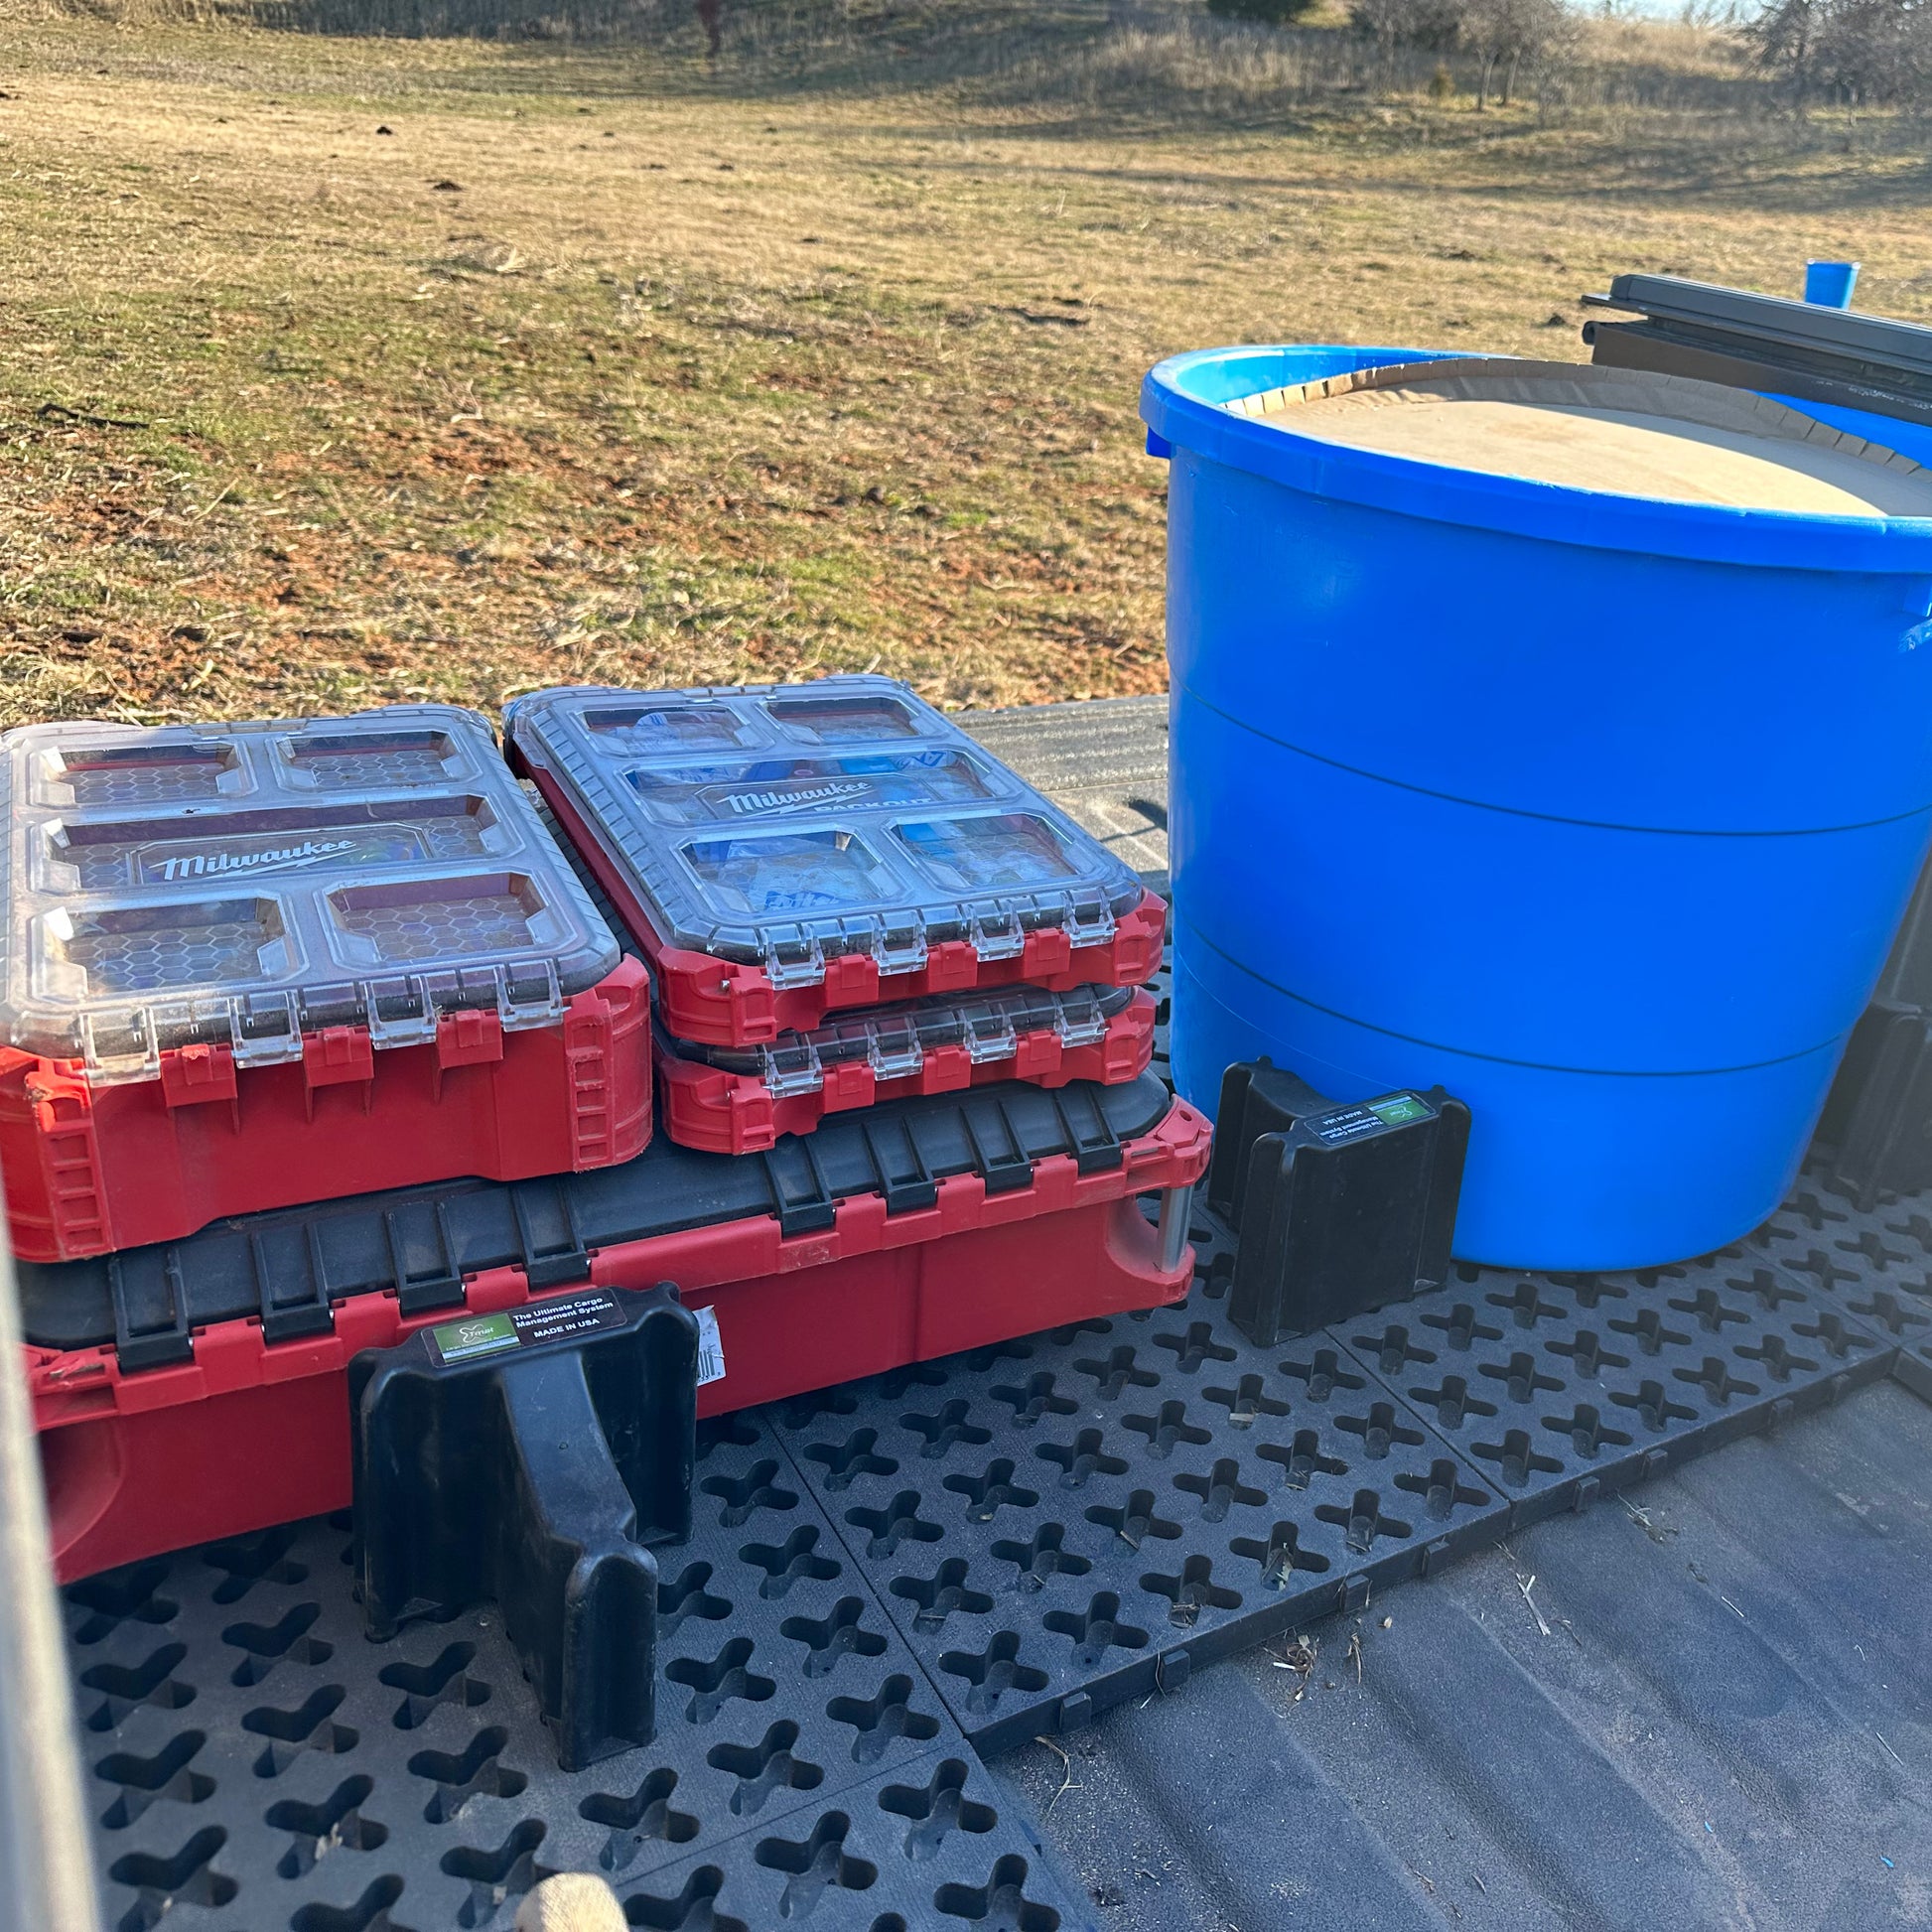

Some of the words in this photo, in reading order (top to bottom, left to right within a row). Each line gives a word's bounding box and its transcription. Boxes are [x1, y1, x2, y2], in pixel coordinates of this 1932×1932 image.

[716, 781, 874, 814] Milwaukee
[149, 840, 357, 881] Milwaukee
[1343, 1111, 1363, 1120] MADE
[515, 1311, 578, 1328] Management
[578, 1302, 614, 1314] System
[533, 1305, 573, 1317] Ultimate
[574, 1298, 604, 1309] Cargo
[533, 1325, 565, 1338] MADE
[565, 1322, 577, 1331] IN
[578, 1317, 601, 1328] USA
